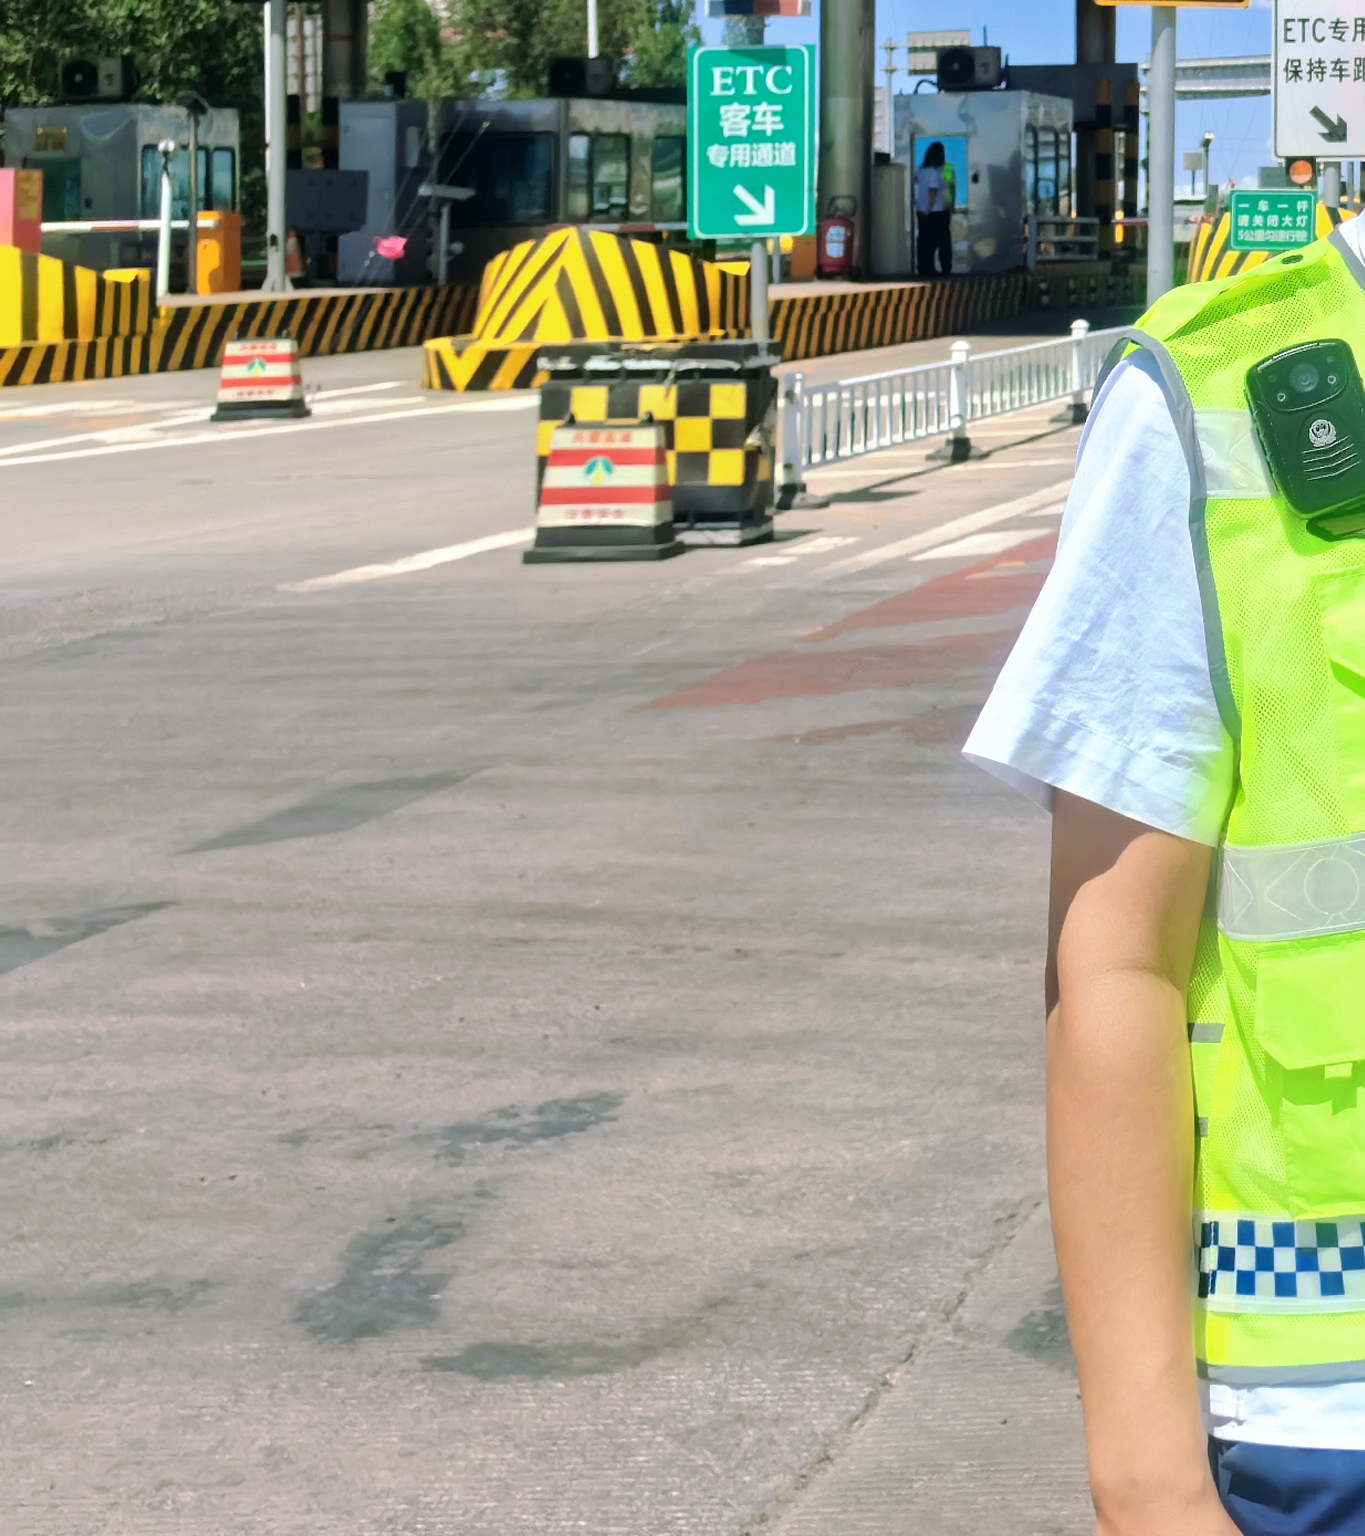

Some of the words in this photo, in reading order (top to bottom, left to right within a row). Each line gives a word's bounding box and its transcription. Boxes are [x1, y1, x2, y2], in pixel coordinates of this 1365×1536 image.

[709, 64, 793, 96] ETC
[719, 100, 785, 138] 客车
[706, 141, 797, 168] 专用通道
